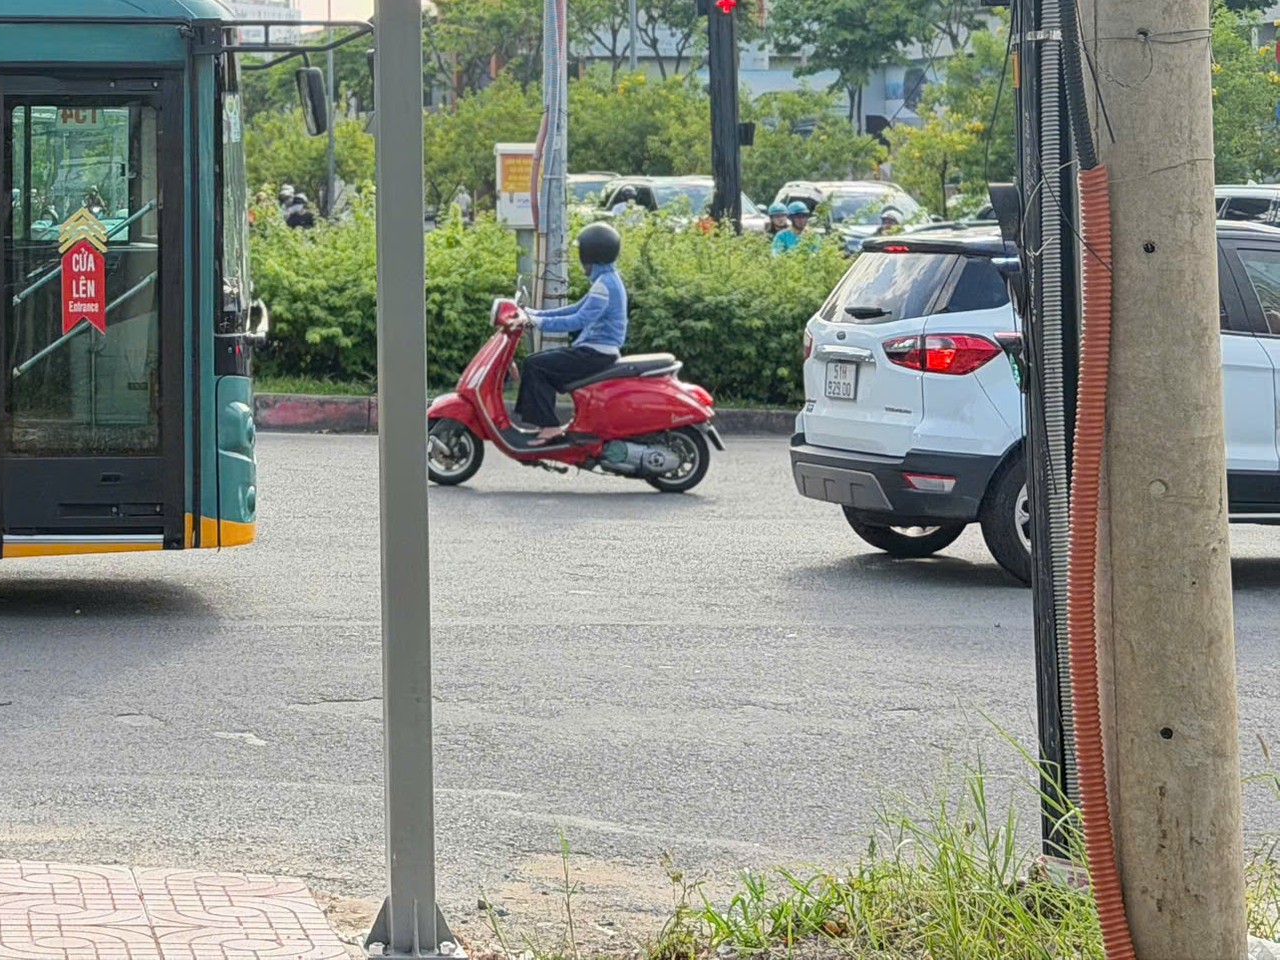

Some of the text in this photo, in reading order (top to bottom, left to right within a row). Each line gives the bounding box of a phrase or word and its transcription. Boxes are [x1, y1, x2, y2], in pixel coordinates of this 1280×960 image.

[72, 247, 96, 272] CỬA
[72, 275, 96, 298] LÊN
[68, 300, 99, 313] Entrance
